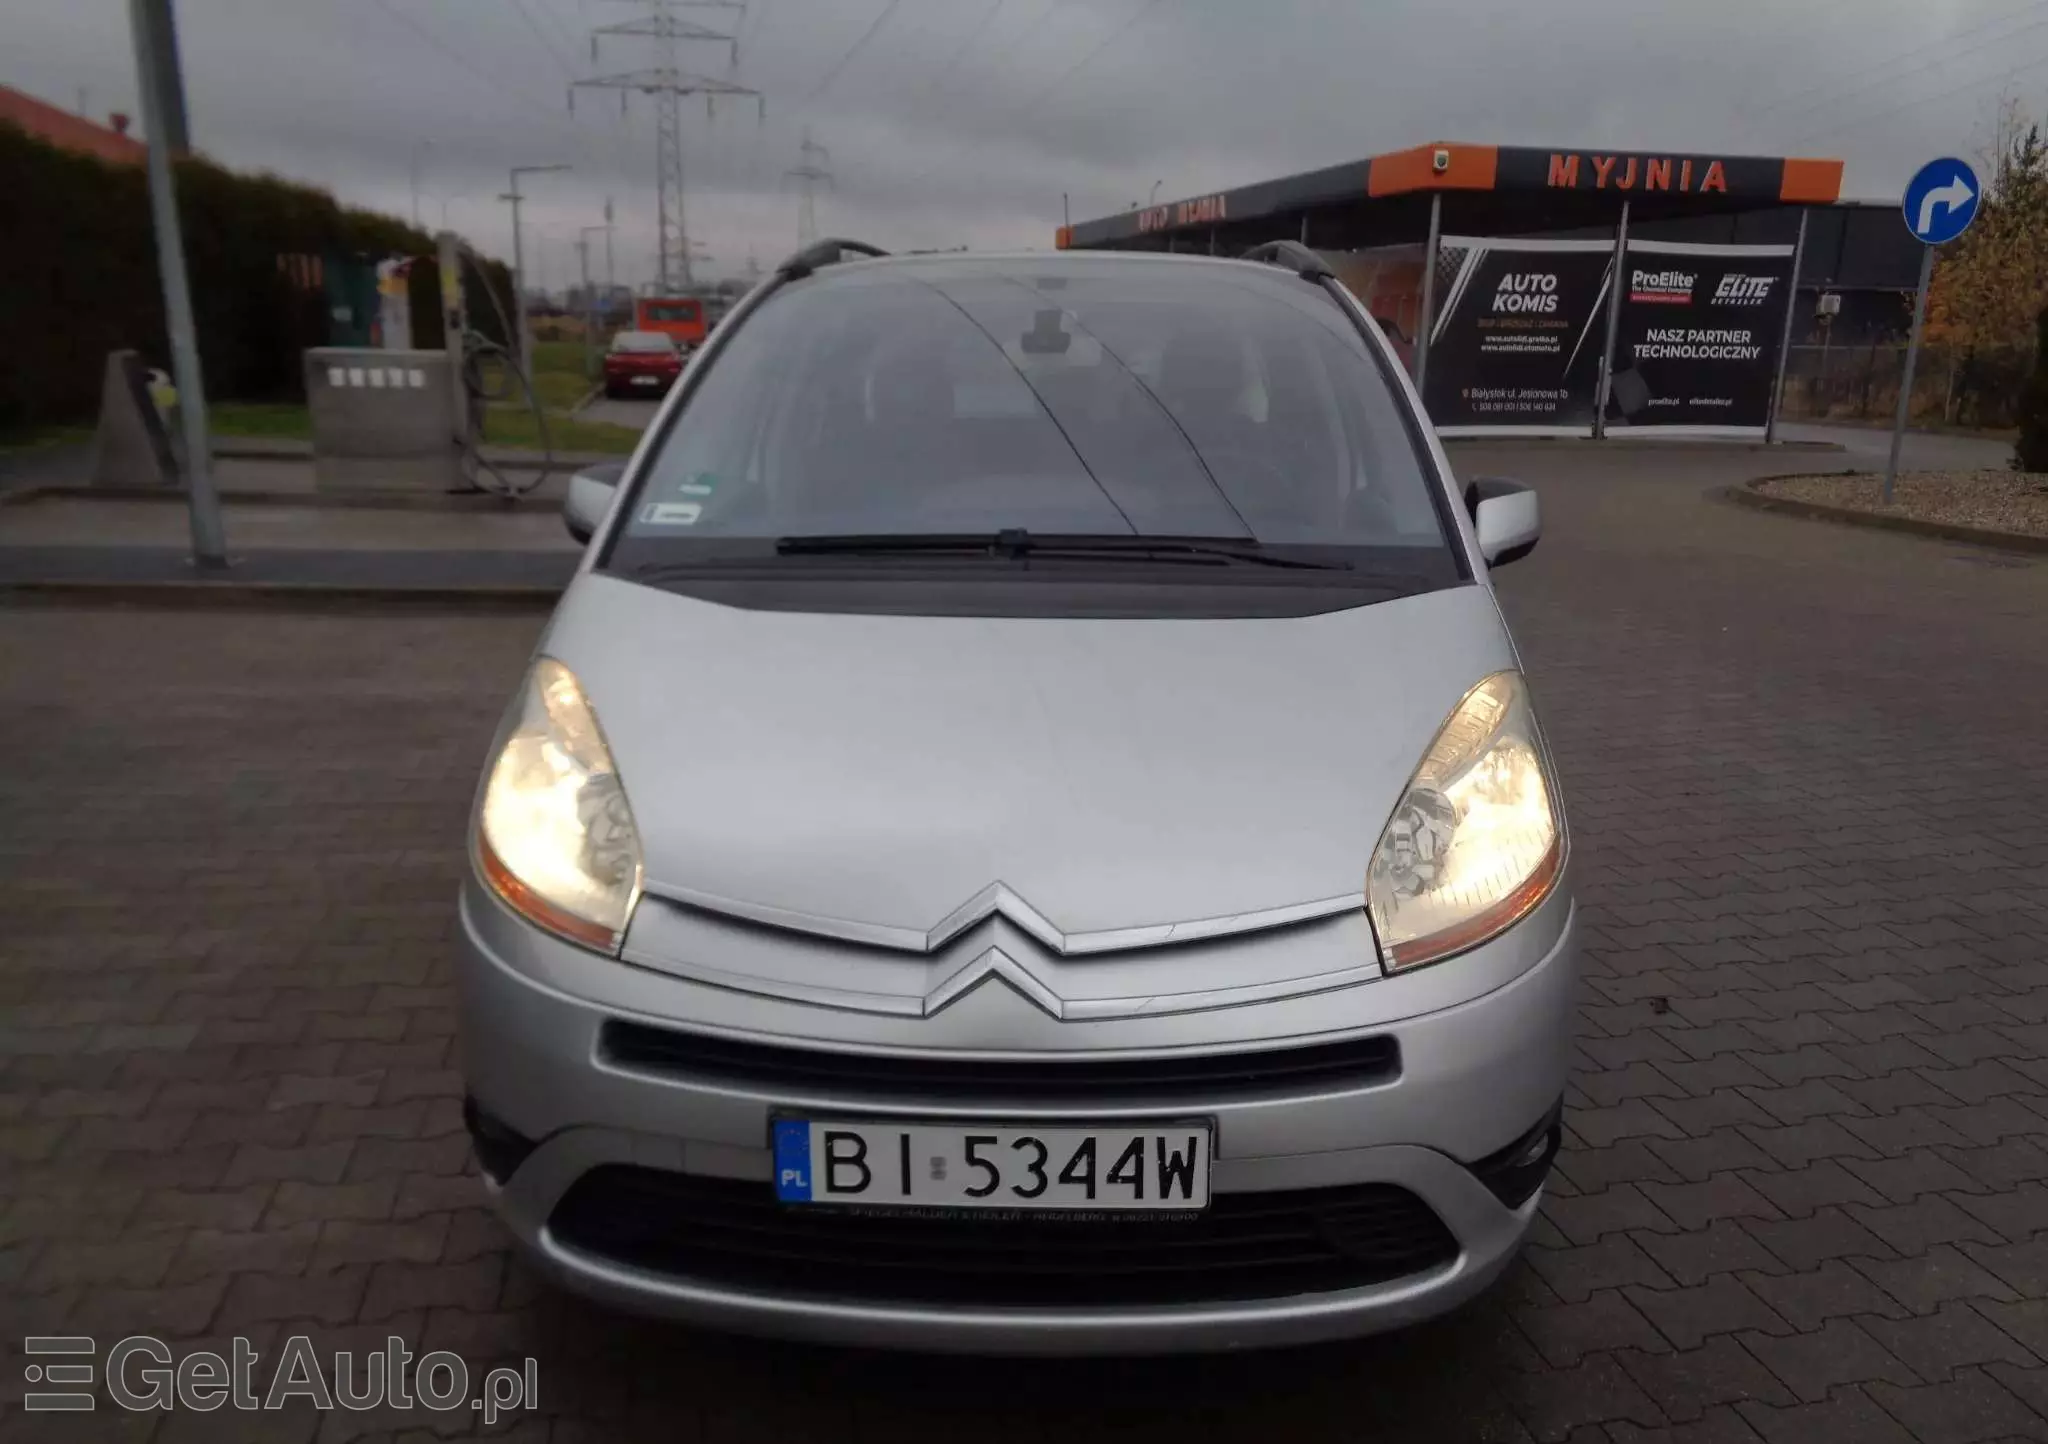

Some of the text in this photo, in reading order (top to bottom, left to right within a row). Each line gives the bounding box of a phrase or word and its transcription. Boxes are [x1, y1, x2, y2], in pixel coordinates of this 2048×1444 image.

[1547, 153, 1728, 193] MYJNIA
[1497, 273, 1557, 292] AUTO
[1631, 270, 1694, 287] ProElite
[1492, 294, 1559, 312] KOMIS
[1646, 329, 1752, 344] NASZ PARTNER
[1633, 344, 1761, 360] TECHNOLOGICZNY
[1471, 387, 1506, 402] Białystok
[1518, 388, 1558, 399] Jesionowa
[823, 1131, 1199, 1200] BI 5344W
[780, 1170, 808, 1188] PL
